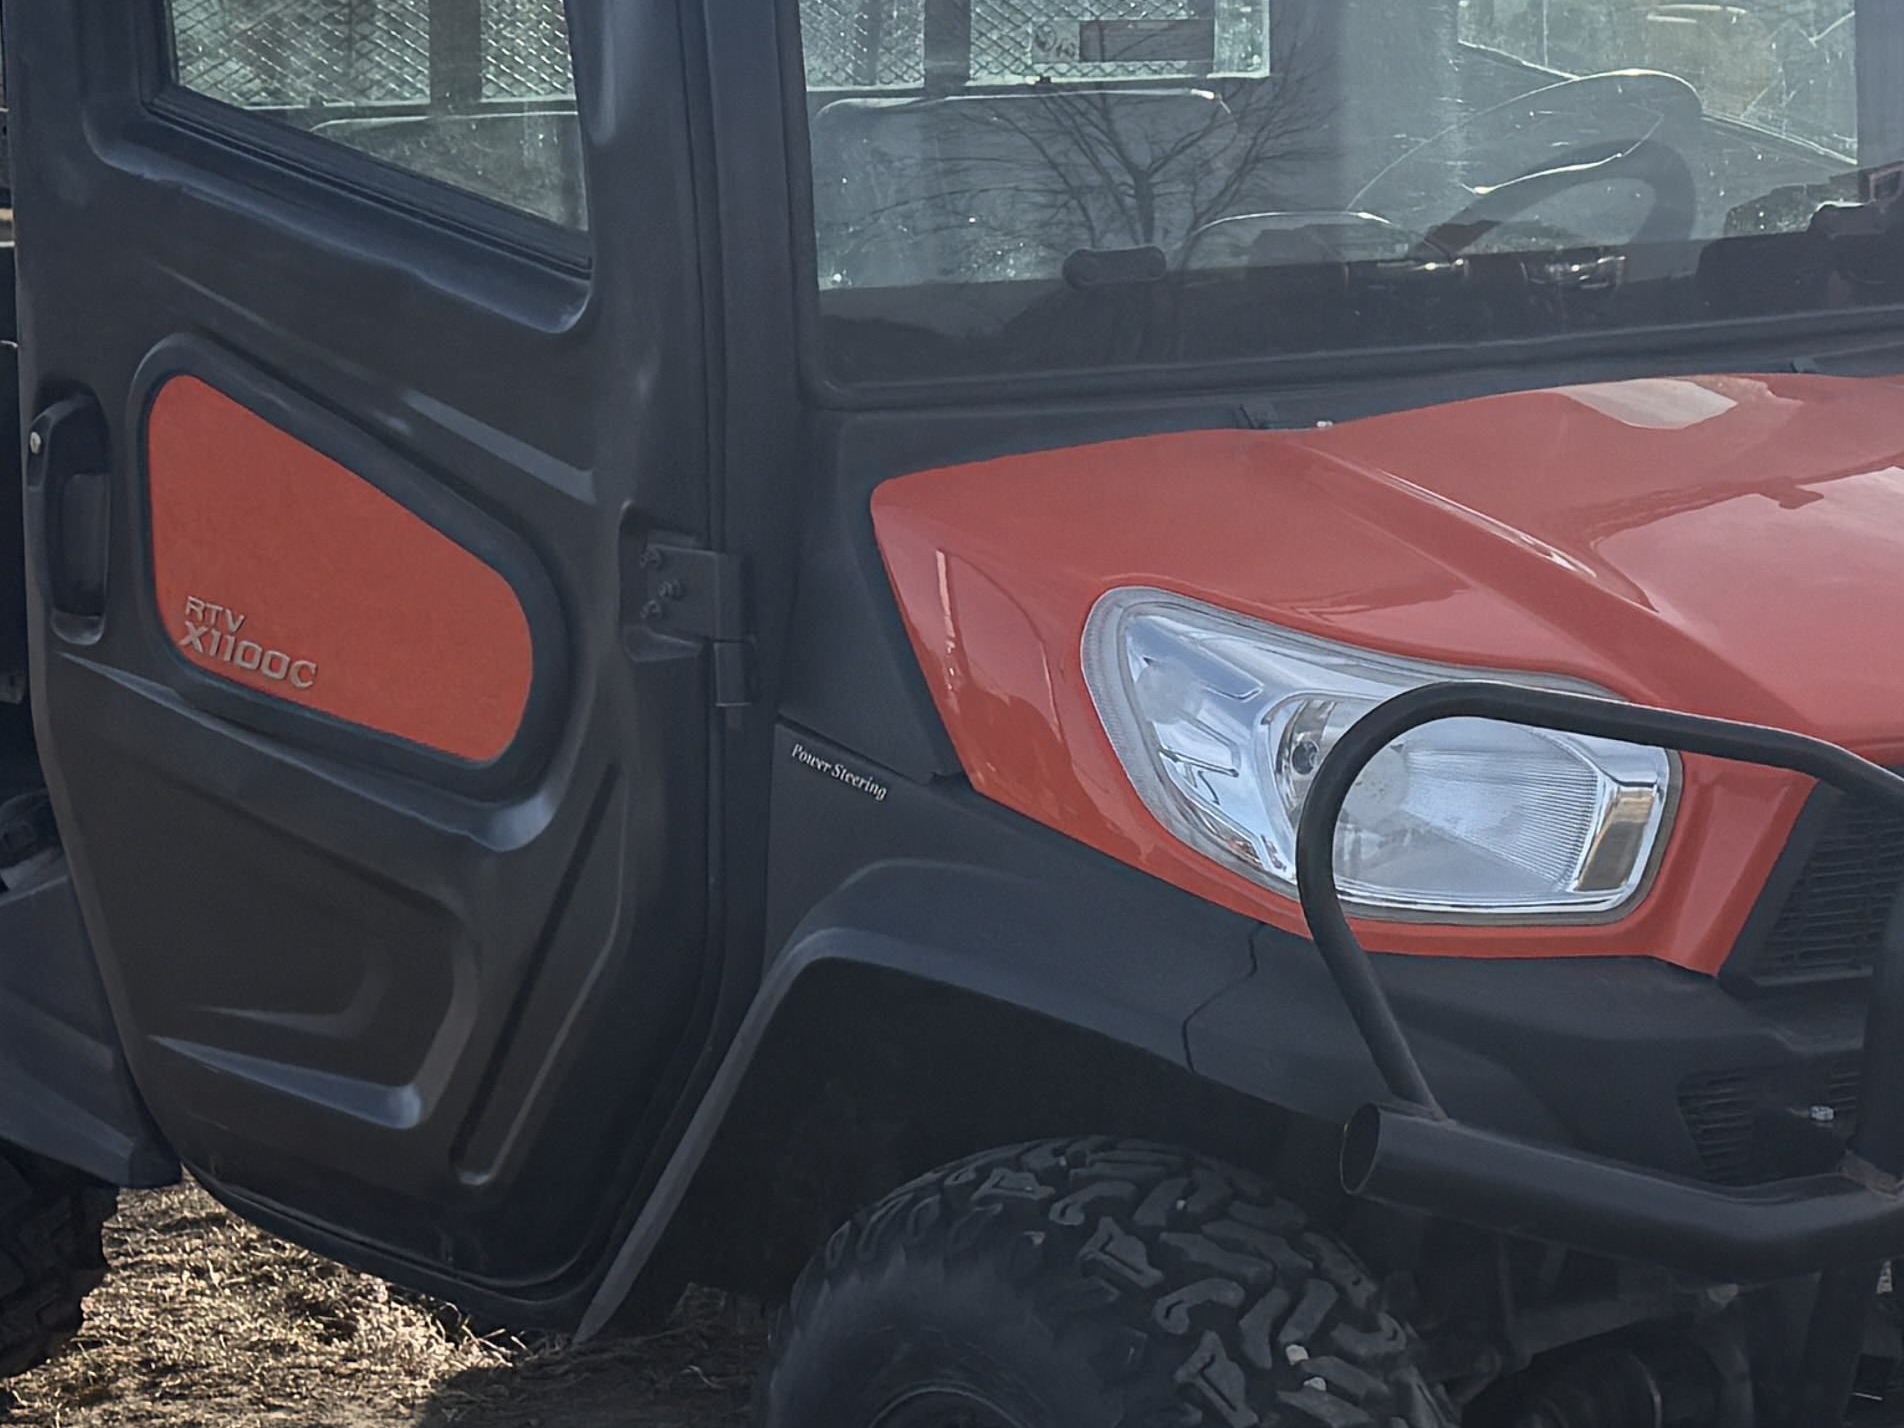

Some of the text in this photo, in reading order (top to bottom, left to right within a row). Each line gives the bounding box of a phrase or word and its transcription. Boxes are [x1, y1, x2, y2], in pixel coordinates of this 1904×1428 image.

[185, 595, 245, 633] RTV
[178, 621, 318, 689] X1100C
[791, 743, 889, 801] Power Steering
